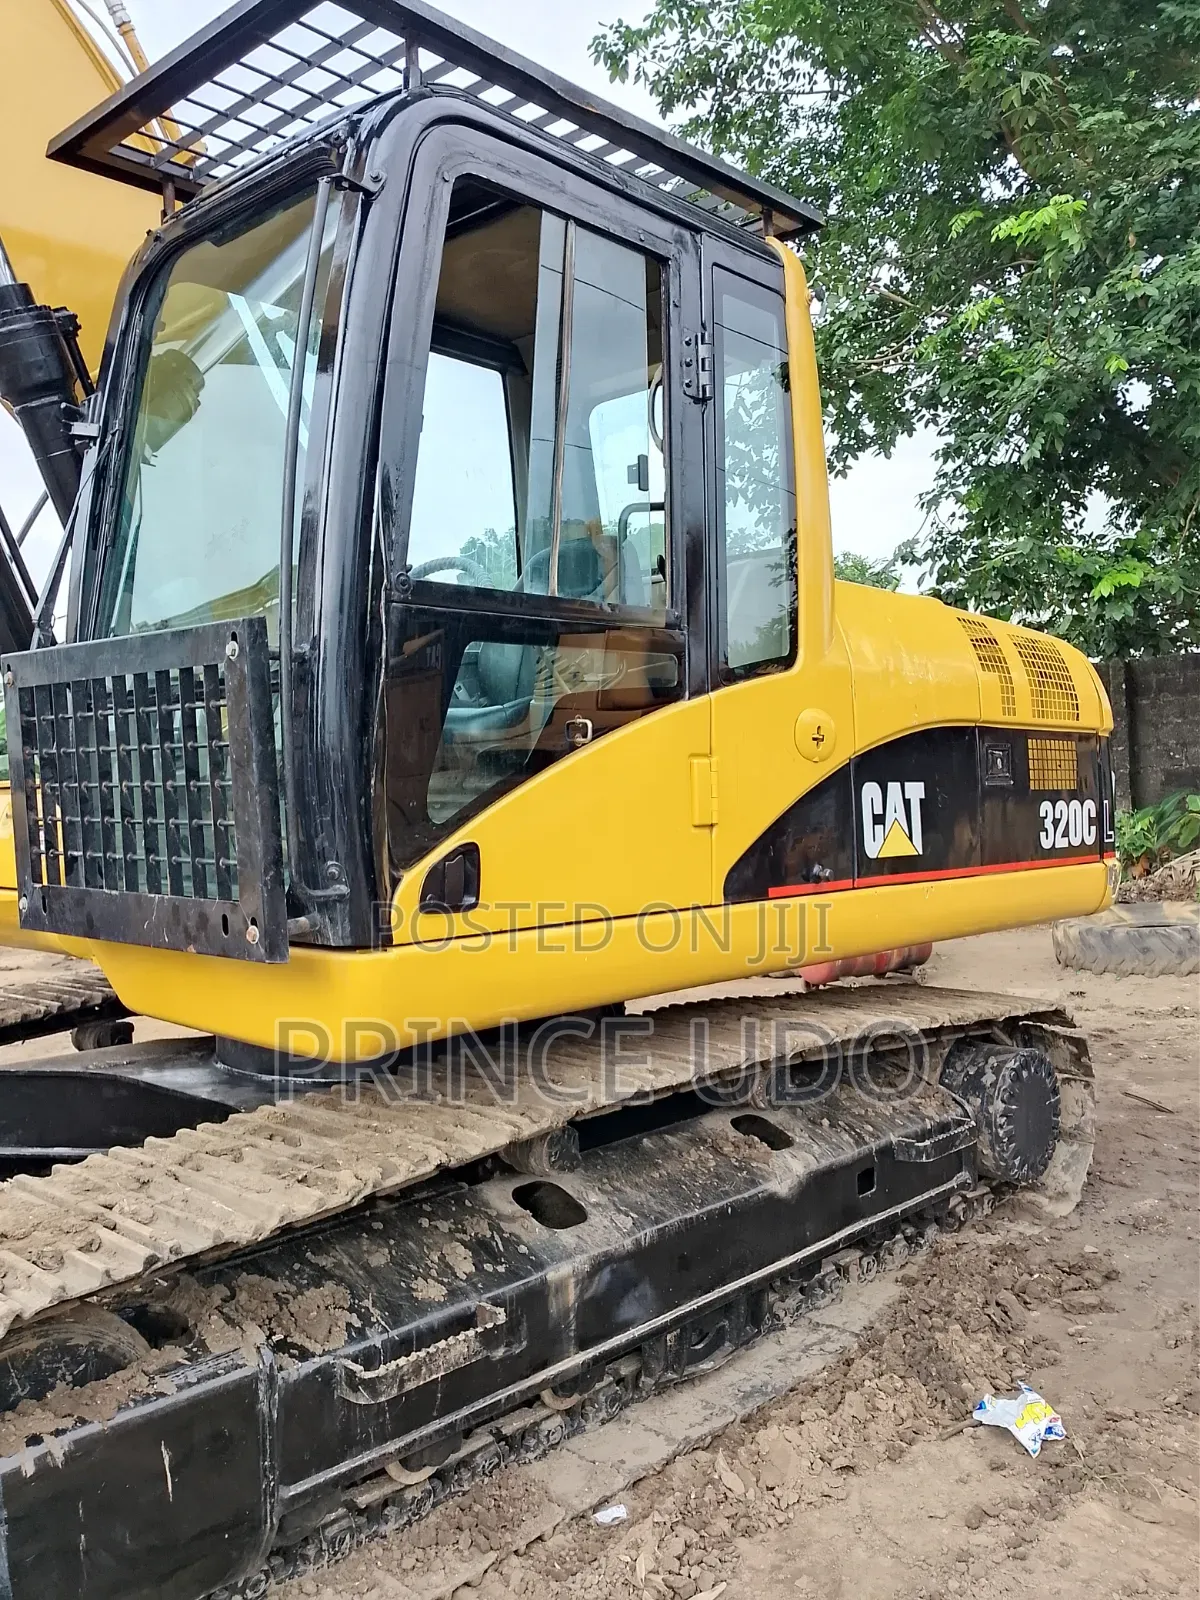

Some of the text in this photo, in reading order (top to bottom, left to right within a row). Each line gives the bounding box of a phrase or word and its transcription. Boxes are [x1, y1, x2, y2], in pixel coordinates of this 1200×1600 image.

[861, 781, 926, 859] CAT
[1039, 799, 1115, 850] 320C L
